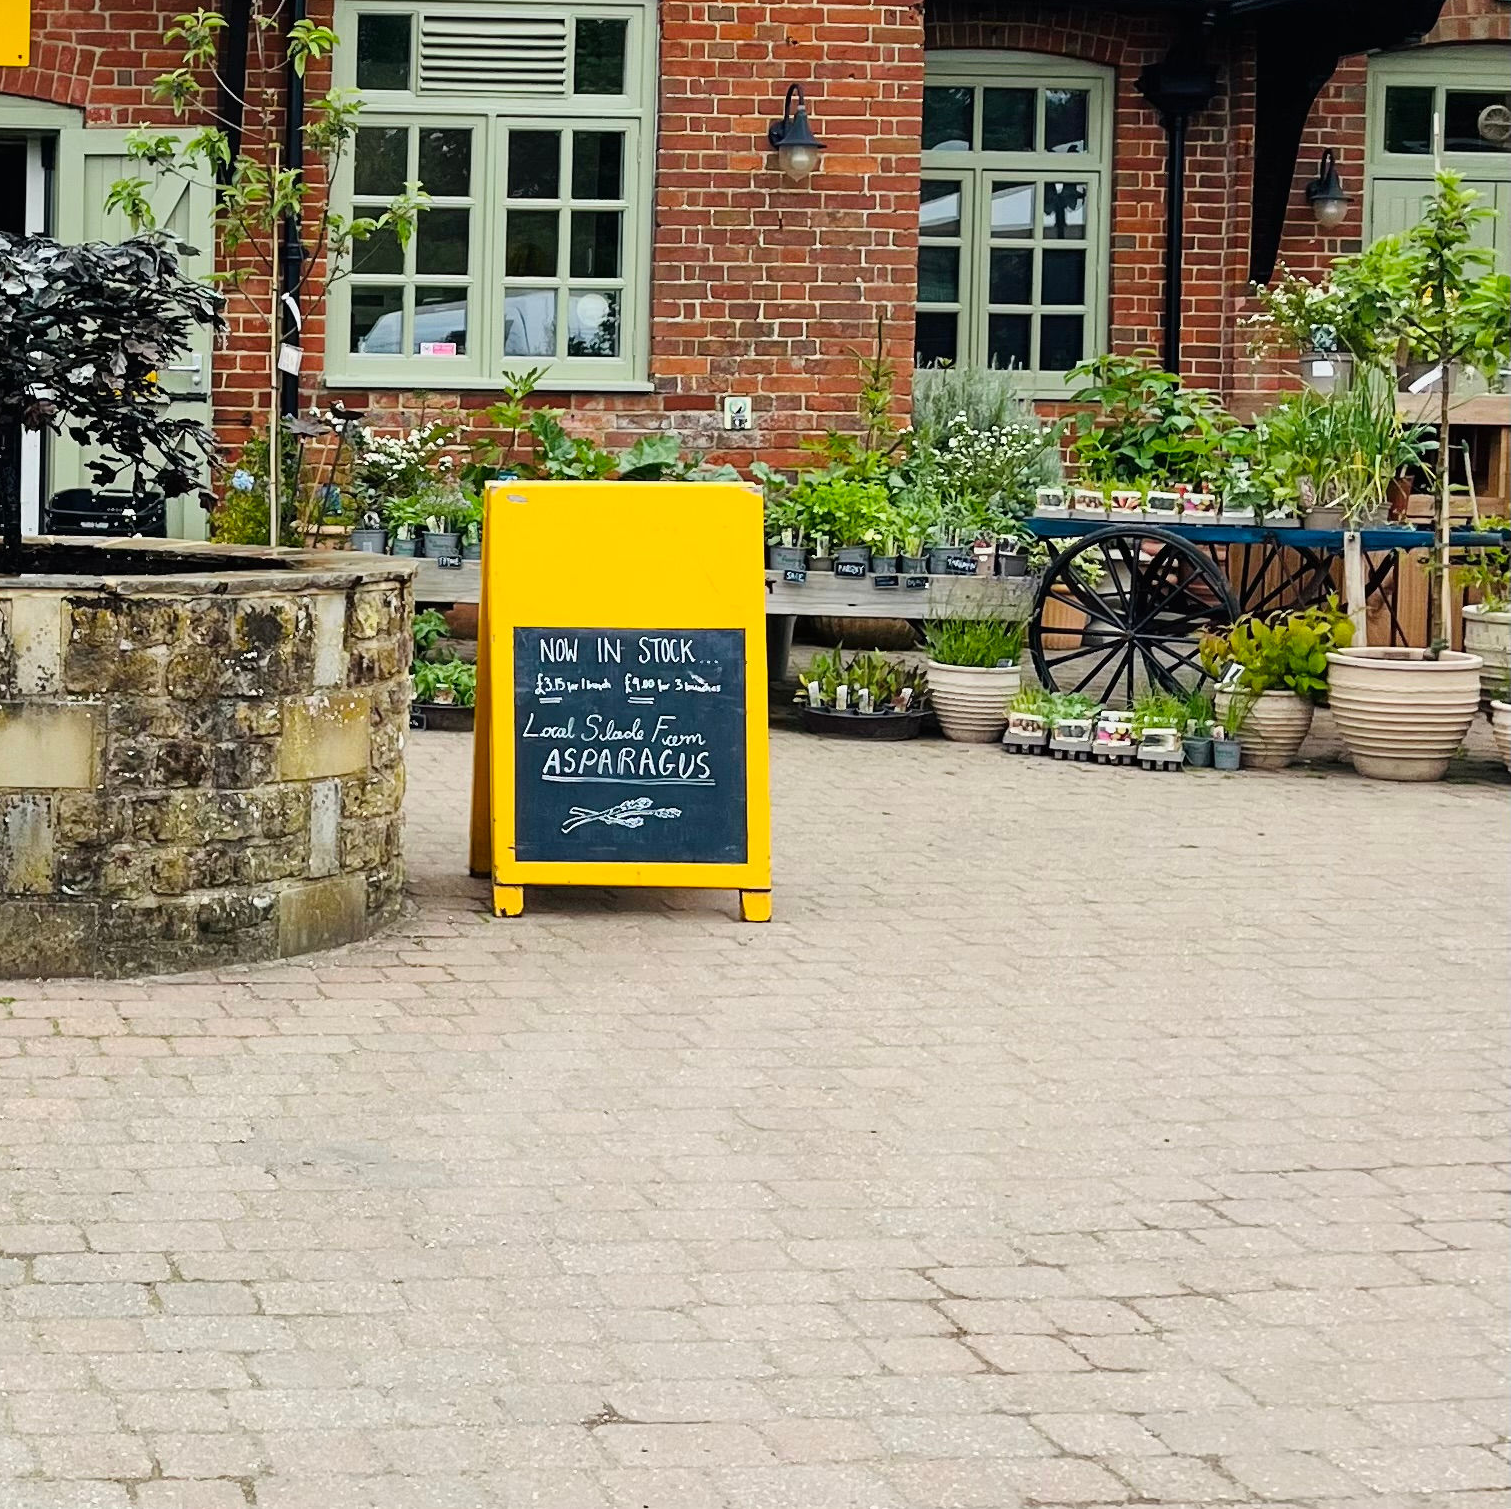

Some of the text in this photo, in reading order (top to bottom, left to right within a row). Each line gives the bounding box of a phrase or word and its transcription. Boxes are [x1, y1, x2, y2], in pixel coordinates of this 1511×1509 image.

[540, 637, 578, 664] NOW
[597, 637, 622, 664] IN
[674, 678, 683, 691] 3
[523, 713, 575, 739] Local
[581, 714, 644, 742] Slade
[542, 747, 712, 779] ASPARAGUS
